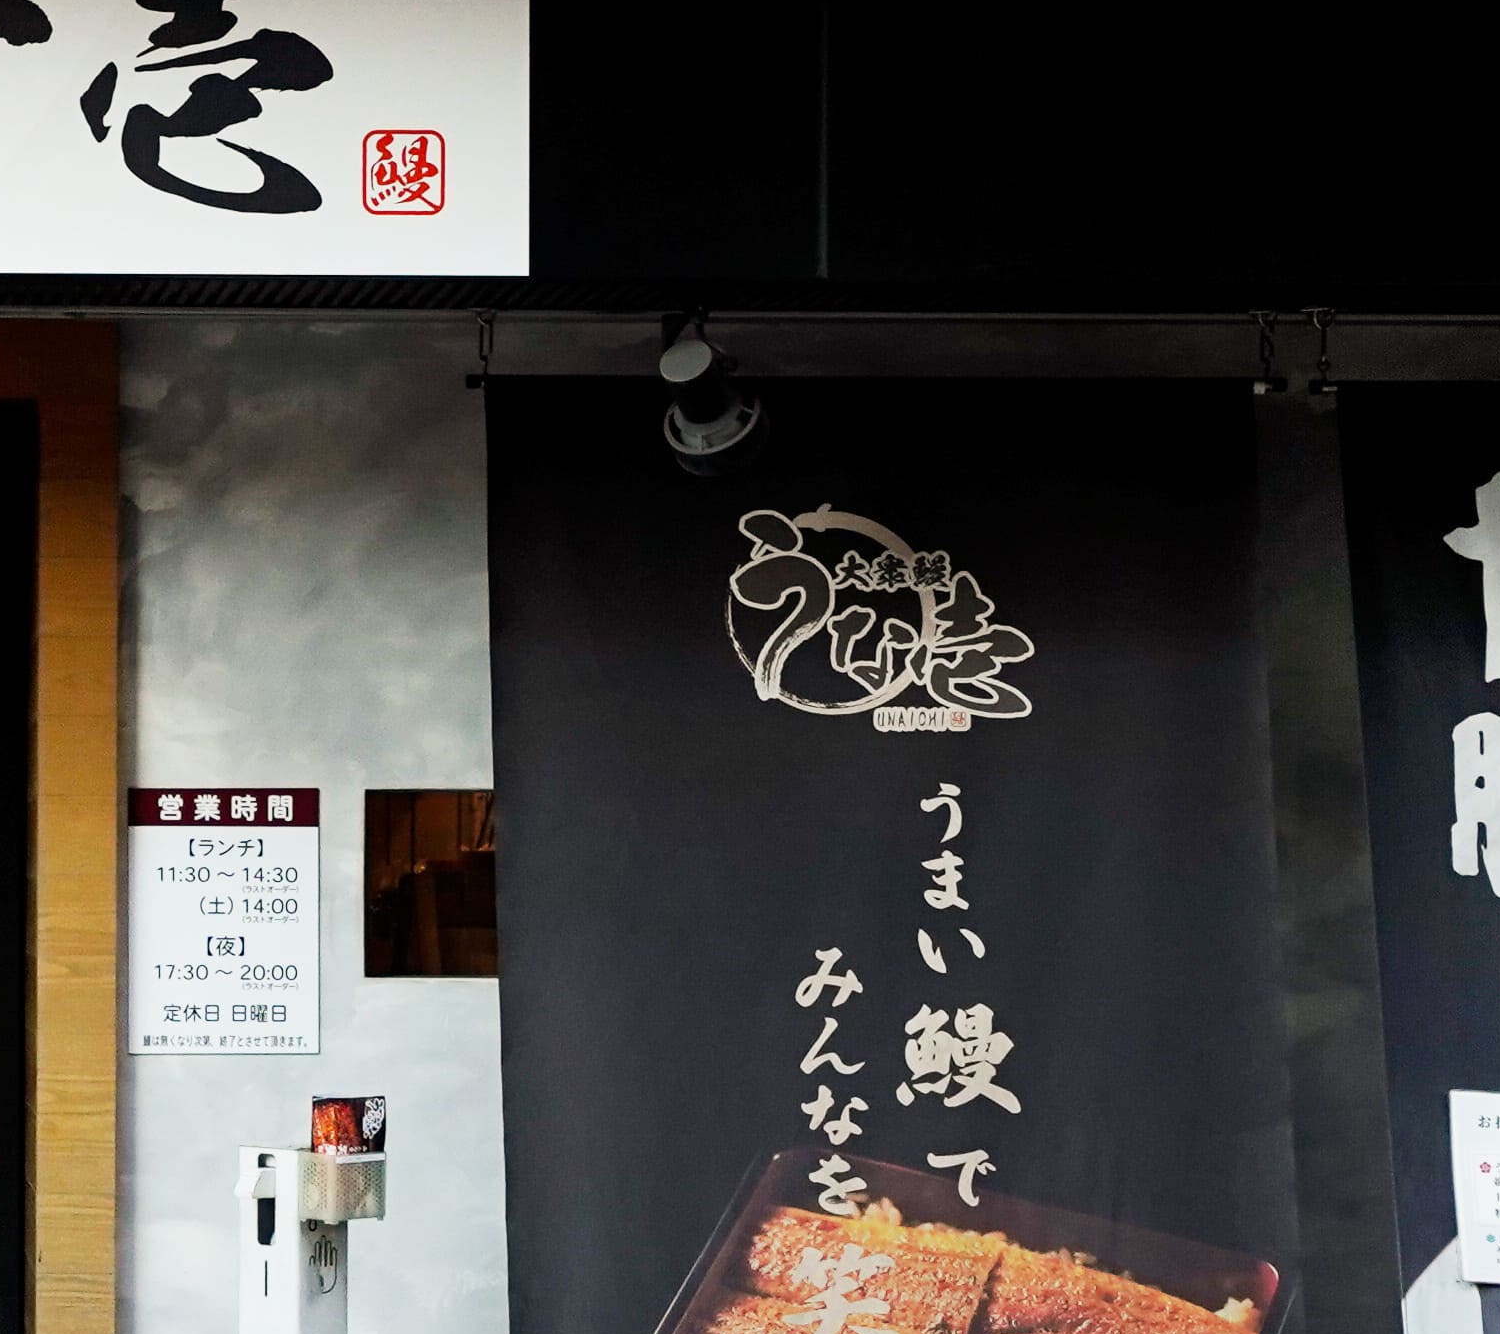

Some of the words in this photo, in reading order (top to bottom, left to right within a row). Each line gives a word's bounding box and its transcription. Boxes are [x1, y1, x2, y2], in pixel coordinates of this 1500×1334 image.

[158, 794, 293, 822] 営業時間
[896, 781, 1021, 1206] うまい鰻で
[163, 1004, 220, 1023] 定休日
[231, 1004, 287, 1022] 日曜日
